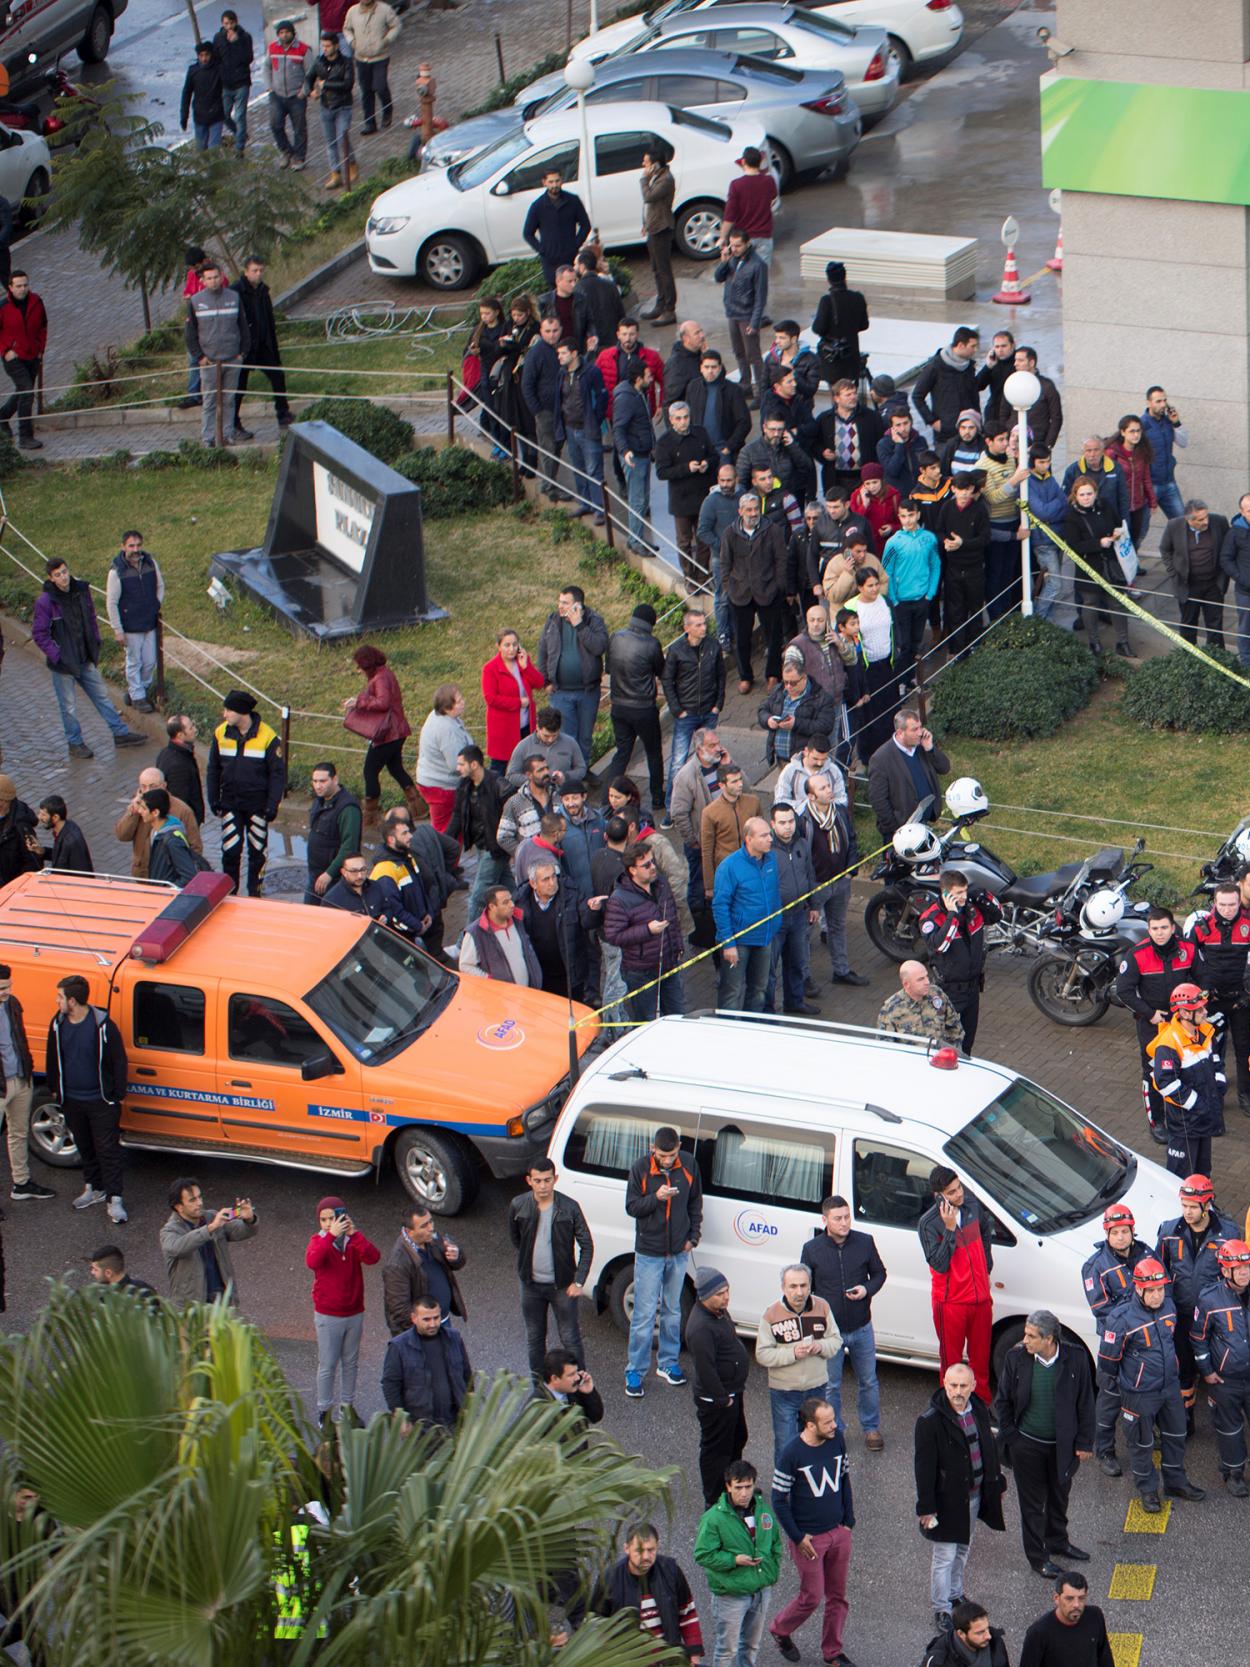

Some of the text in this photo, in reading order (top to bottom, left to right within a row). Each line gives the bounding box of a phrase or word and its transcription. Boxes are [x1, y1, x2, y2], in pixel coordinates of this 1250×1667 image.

[168, 1089, 230, 1105] KURTARMA
[232, 1096, 274, 1110] BİRLİĞİ
[318, 1106, 353, 1120] İZMİR
[749, 1222, 778, 1236] AFAD
[797, 1454, 844, 1498] W
